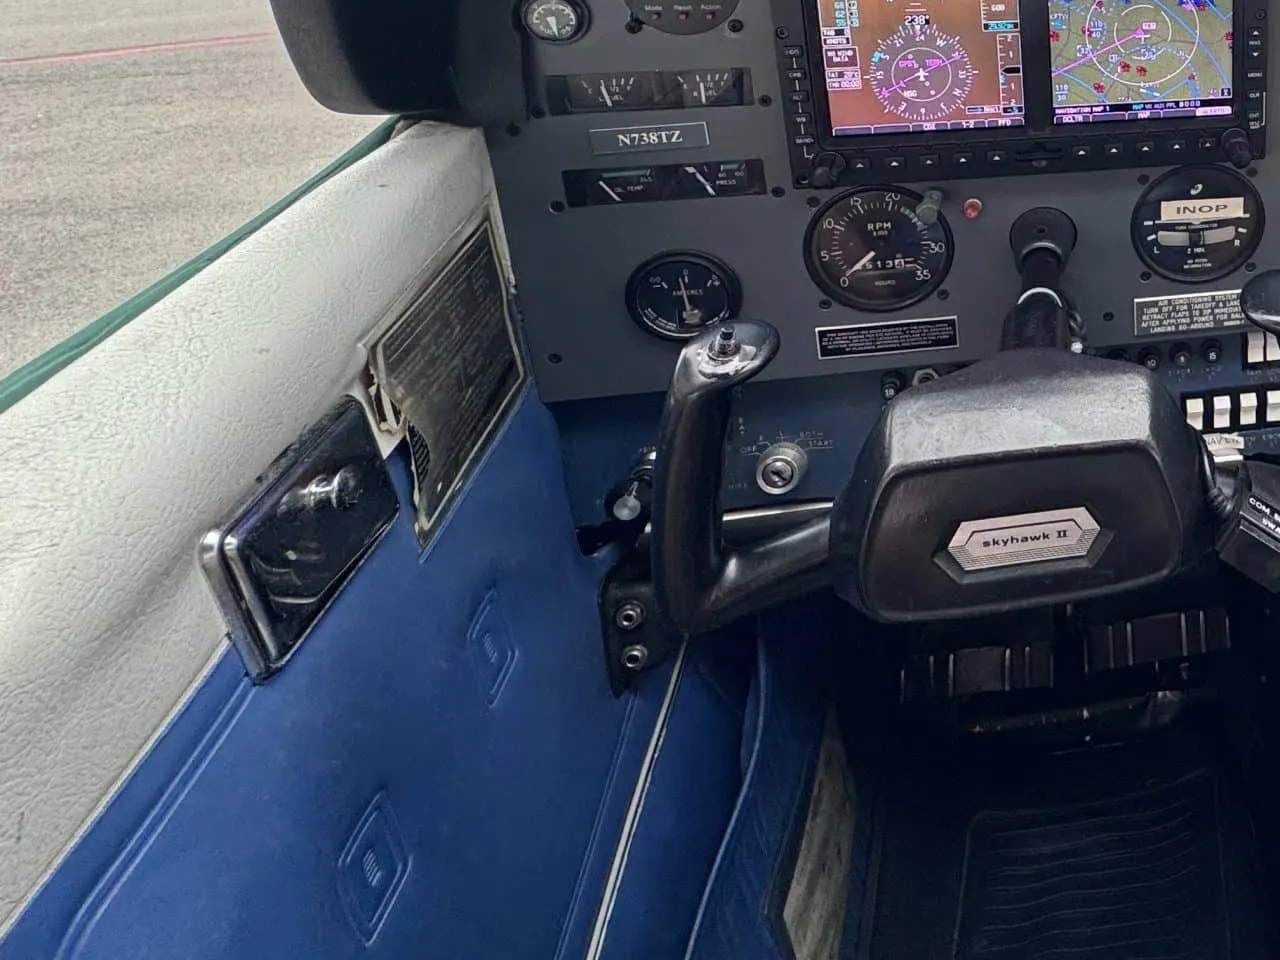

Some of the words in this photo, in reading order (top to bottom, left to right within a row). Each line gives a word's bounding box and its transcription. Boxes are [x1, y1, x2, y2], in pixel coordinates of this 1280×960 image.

[904, 16, 929, 24] 238°
[618, 130, 682, 146] N738TZ
[851, 196, 862, 206] 15
[1176, 204, 1228, 214] INOP
[823, 218, 834, 228] 10
[929, 243, 944, 253] 30
[821, 250, 829, 261] 5
[915, 270, 931, 280] 35
[840, 277, 848, 287] 0
[1249, 497, 1270, 516] COM
[982, 532, 1050, 548] skyhawk
[1056, 530, 1068, 539] II
